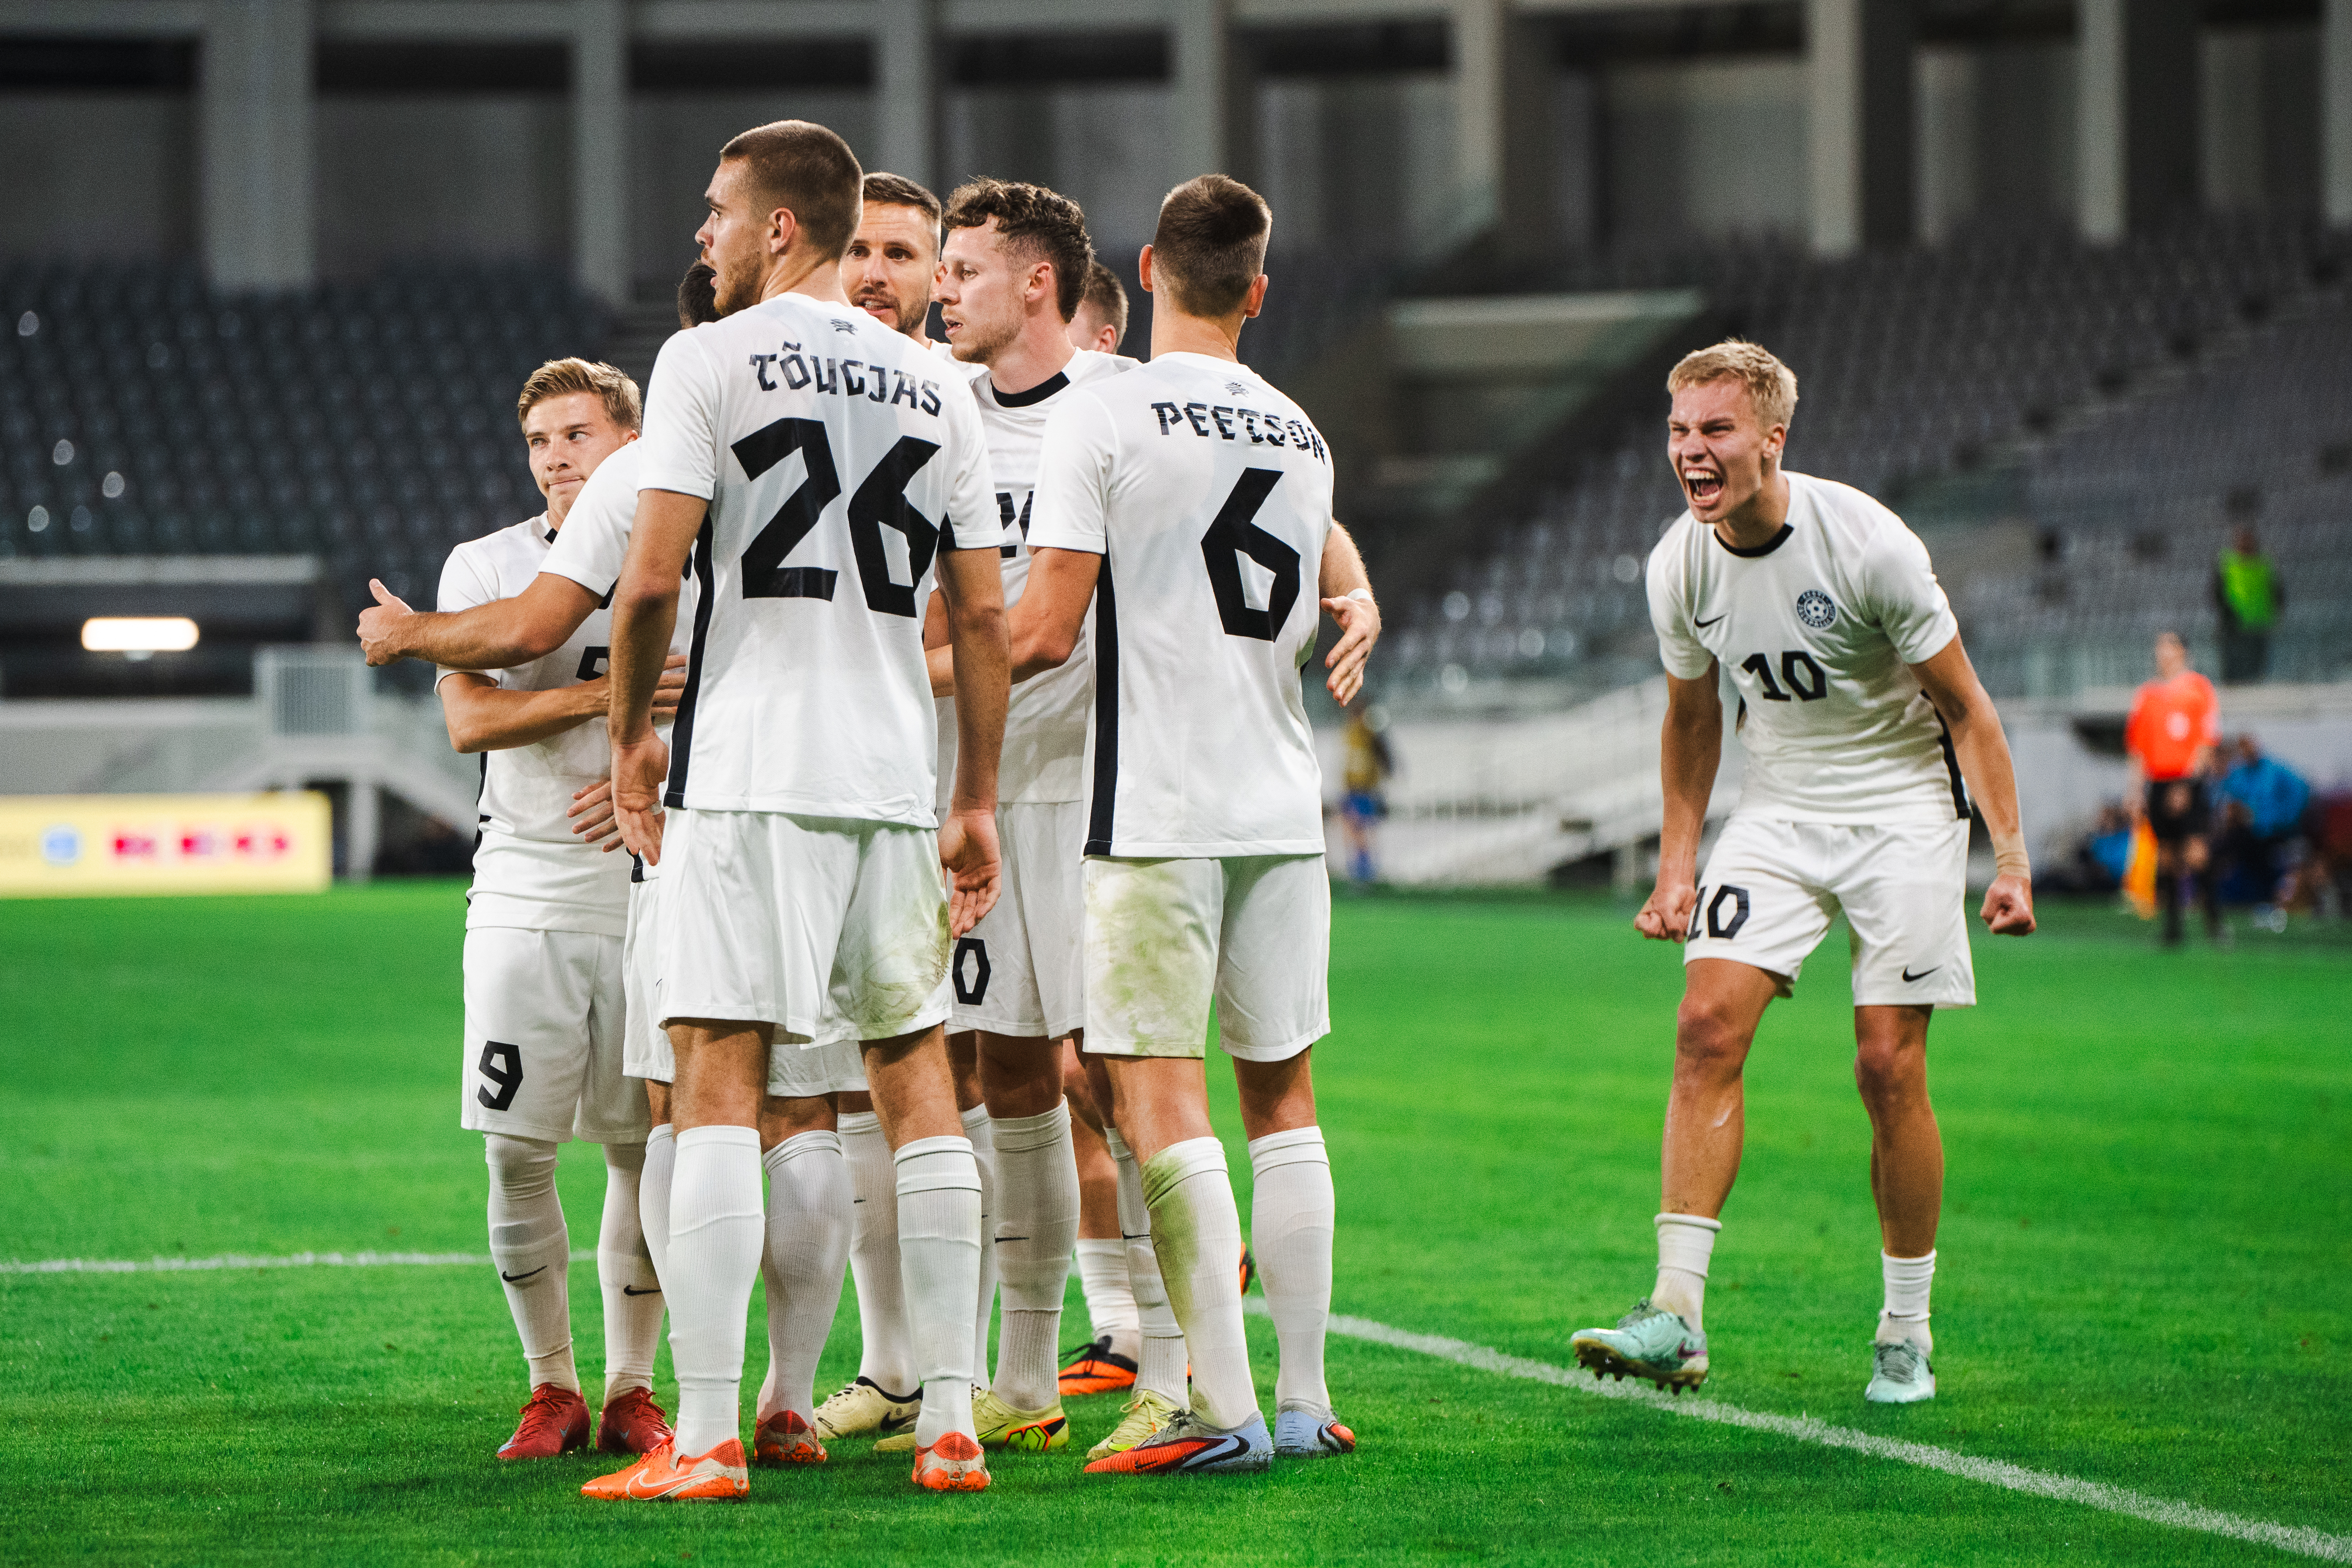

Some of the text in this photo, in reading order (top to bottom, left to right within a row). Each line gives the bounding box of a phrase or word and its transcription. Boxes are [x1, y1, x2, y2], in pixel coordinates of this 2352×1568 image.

[749, 341, 942, 417] TÕUGJAS
[1151, 401, 1326, 466] PEETSON
[730, 417, 942, 618] 26
[1200, 467, 1301, 643] 6
[1741, 650, 1828, 702] 10
[1687, 884, 1750, 942] 10
[477, 1040, 524, 1112] 9
